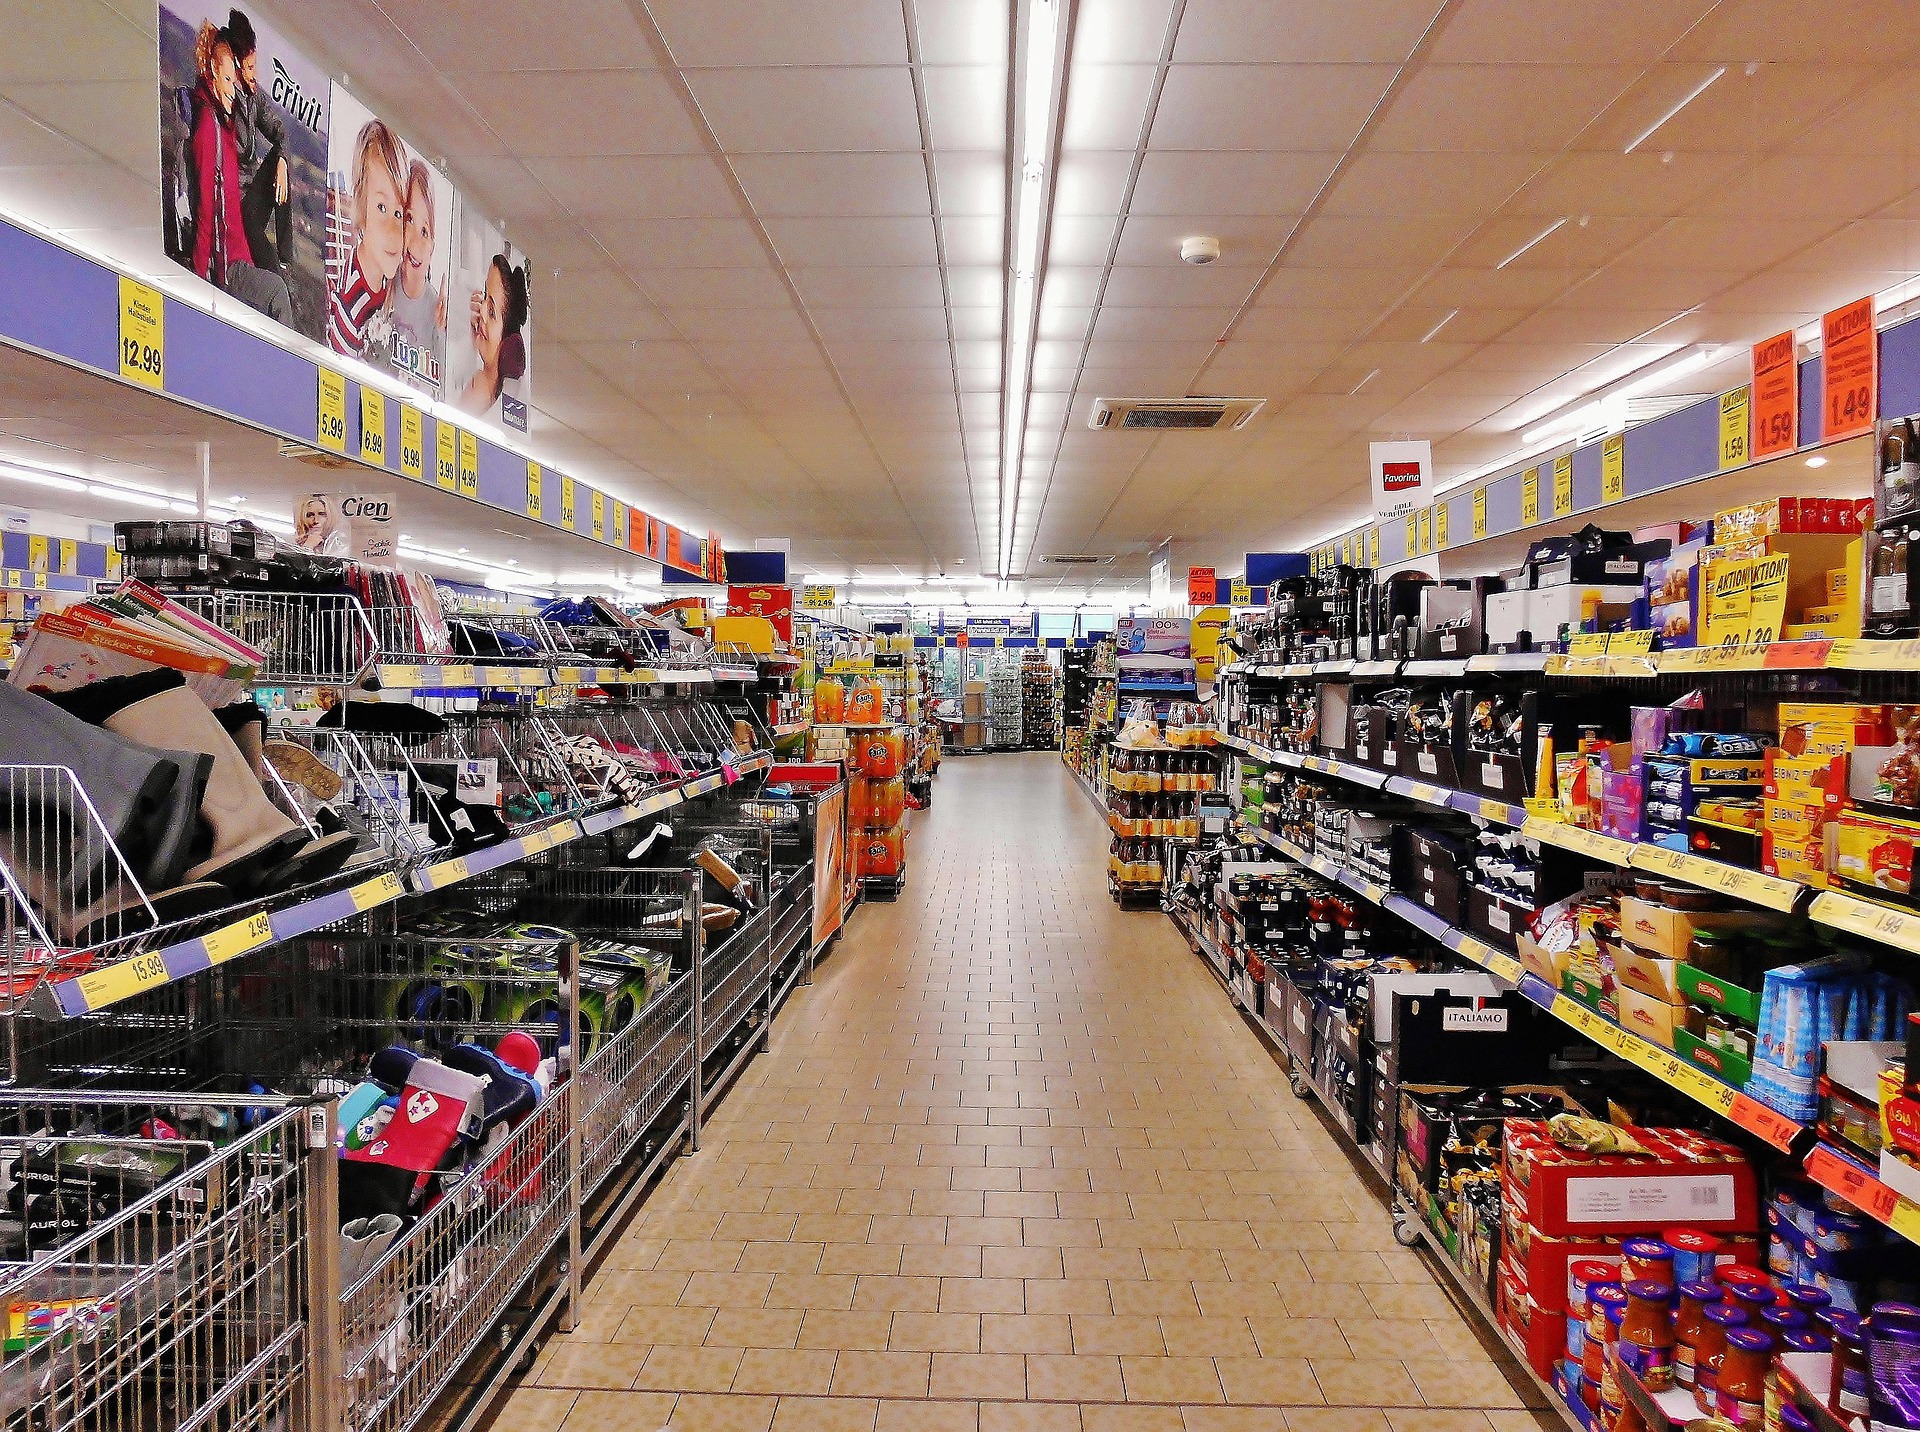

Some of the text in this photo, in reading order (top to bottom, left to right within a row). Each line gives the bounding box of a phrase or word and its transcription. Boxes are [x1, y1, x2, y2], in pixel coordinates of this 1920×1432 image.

[272, 77, 321, 132] crivit
[133, 299, 151, 314] Kinder
[123, 337, 161, 376] 12.99
[1832, 386, 1870, 426] 1.49
[322, 413, 343, 440] 5.99
[1760, 412, 1792, 448] 1.59
[365, 430, 382, 455] 6.99
[1725, 437, 1743, 460] 1.59
[403, 447, 420, 469] 9.99
[439, 460, 454, 481] 3.99
[461, 468, 477, 488] 4.99
[1385, 473, 1419, 482] Favorina
[341, 497, 388, 516] Cien
[131, 584, 162, 606] Melinera
[817, 599, 833, 607] 2.49
[1191, 591, 1212, 602] 2.99
[1151, 620, 1180, 629] 100%
[91, 633, 155, 657] Sticker-Set
[856, 694, 874, 705] Fanta
[869, 749, 887, 758] Fanta
[1719, 870, 1739, 888] 1.29
[248, 915, 269, 938] 2.99
[1876, 912, 1904, 934] 1.99
[132, 955, 164, 982] 15.99
[1448, 1013, 1503, 1023] ITALIAMO
[1662, 1060, 1679, 1078] -.99
[1715, 1088, 1735, 1107] -.99
[15, 1171, 58, 1182] AURIOL
[30, 1220, 79, 1230] AUROL
